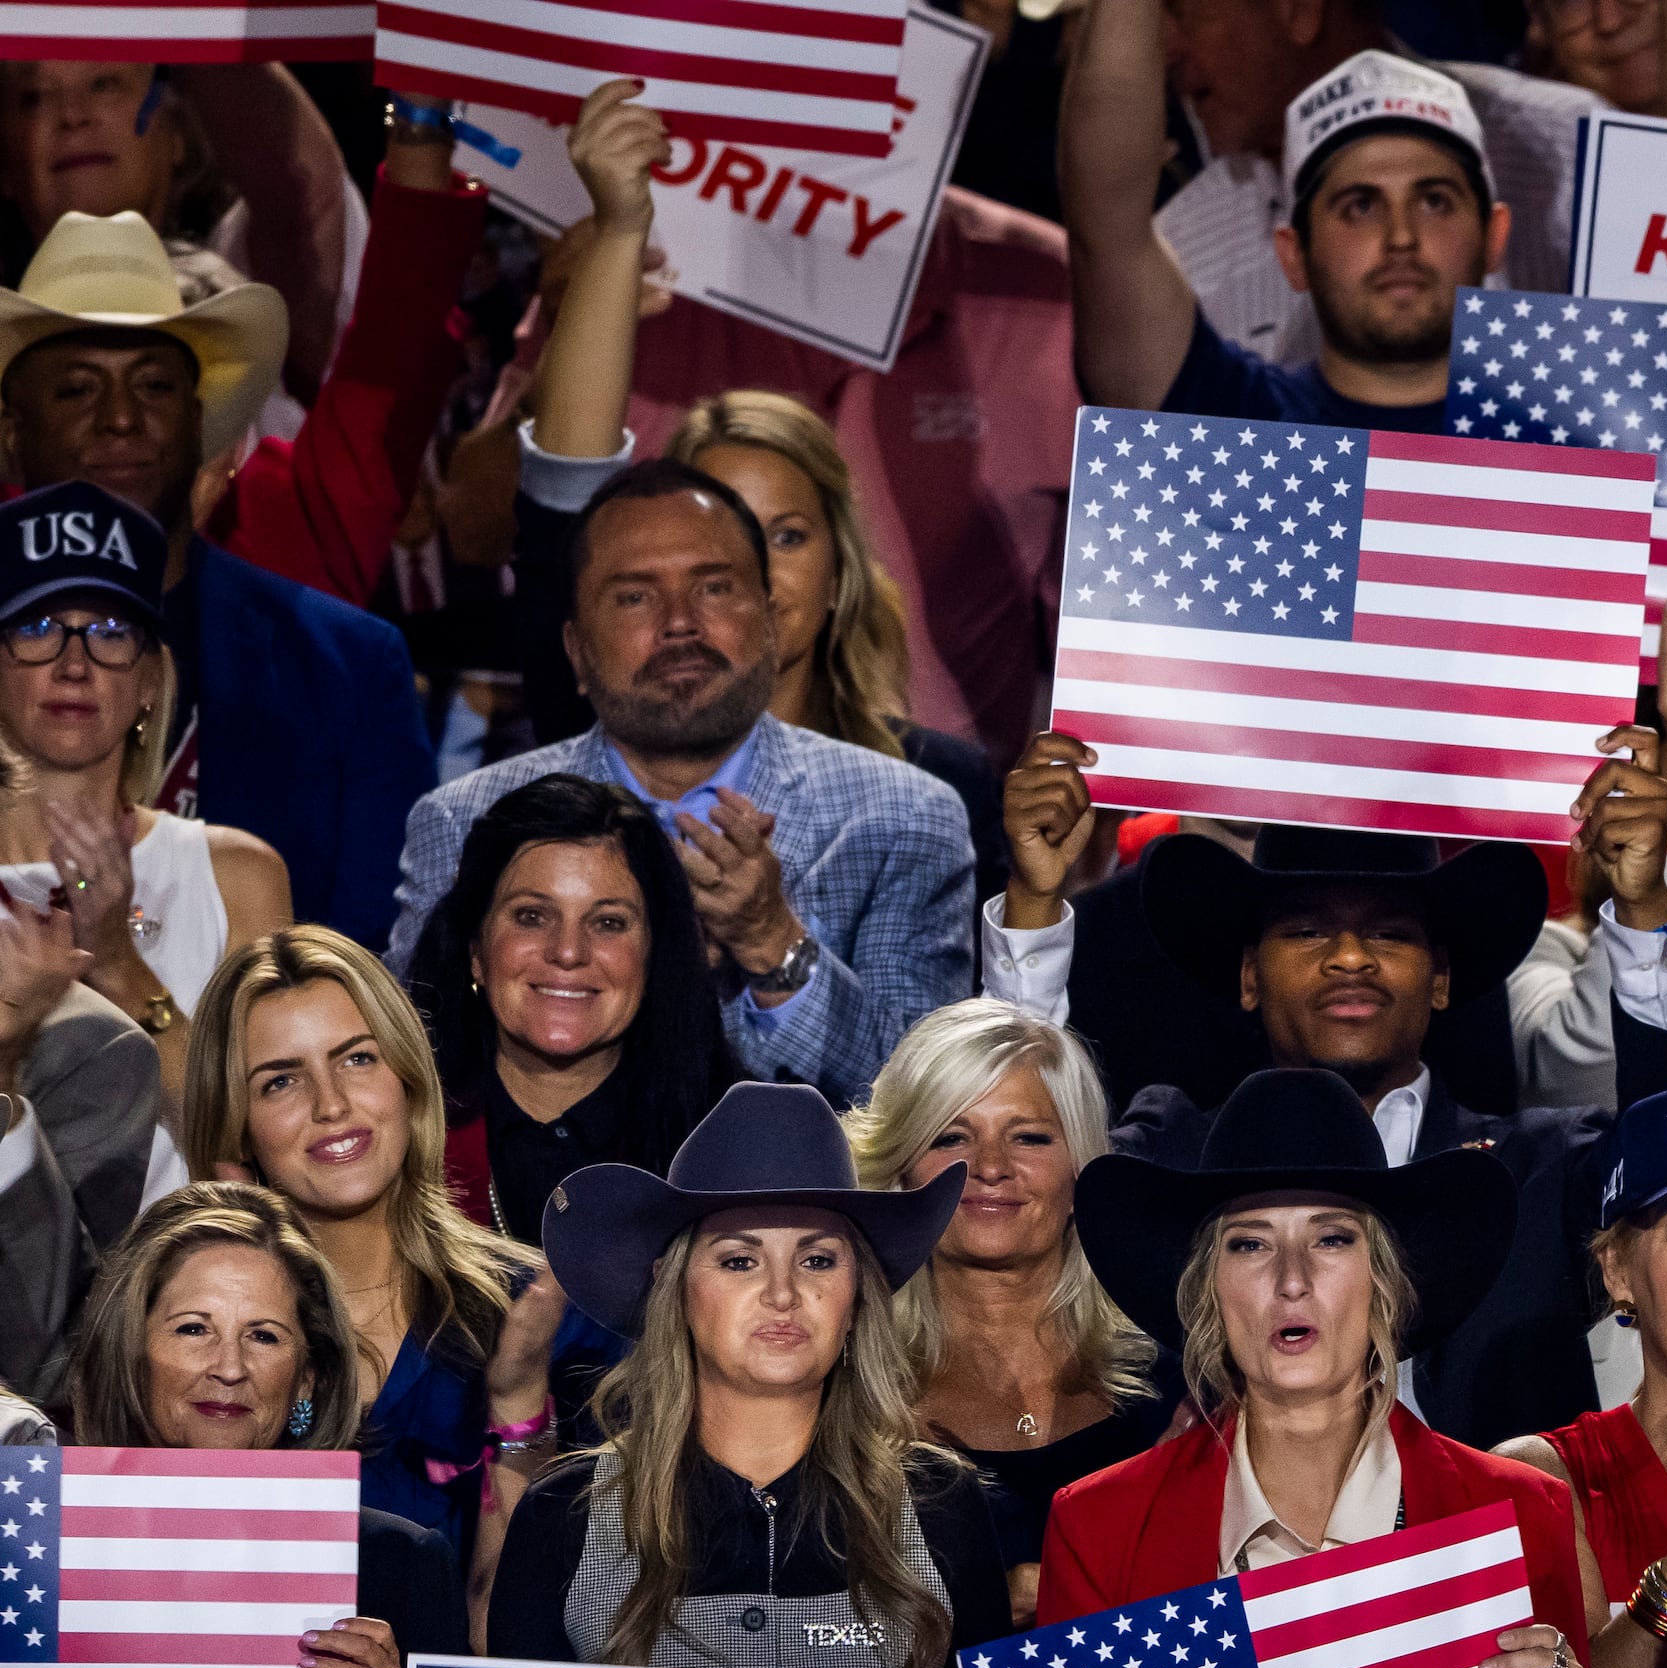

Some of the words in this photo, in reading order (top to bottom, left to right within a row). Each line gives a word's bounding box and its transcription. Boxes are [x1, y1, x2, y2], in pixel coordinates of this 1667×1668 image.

[651, 137, 906, 259] ORITY
[18, 511, 138, 571] USA
[803, 1622, 885, 1646] TEXAS
